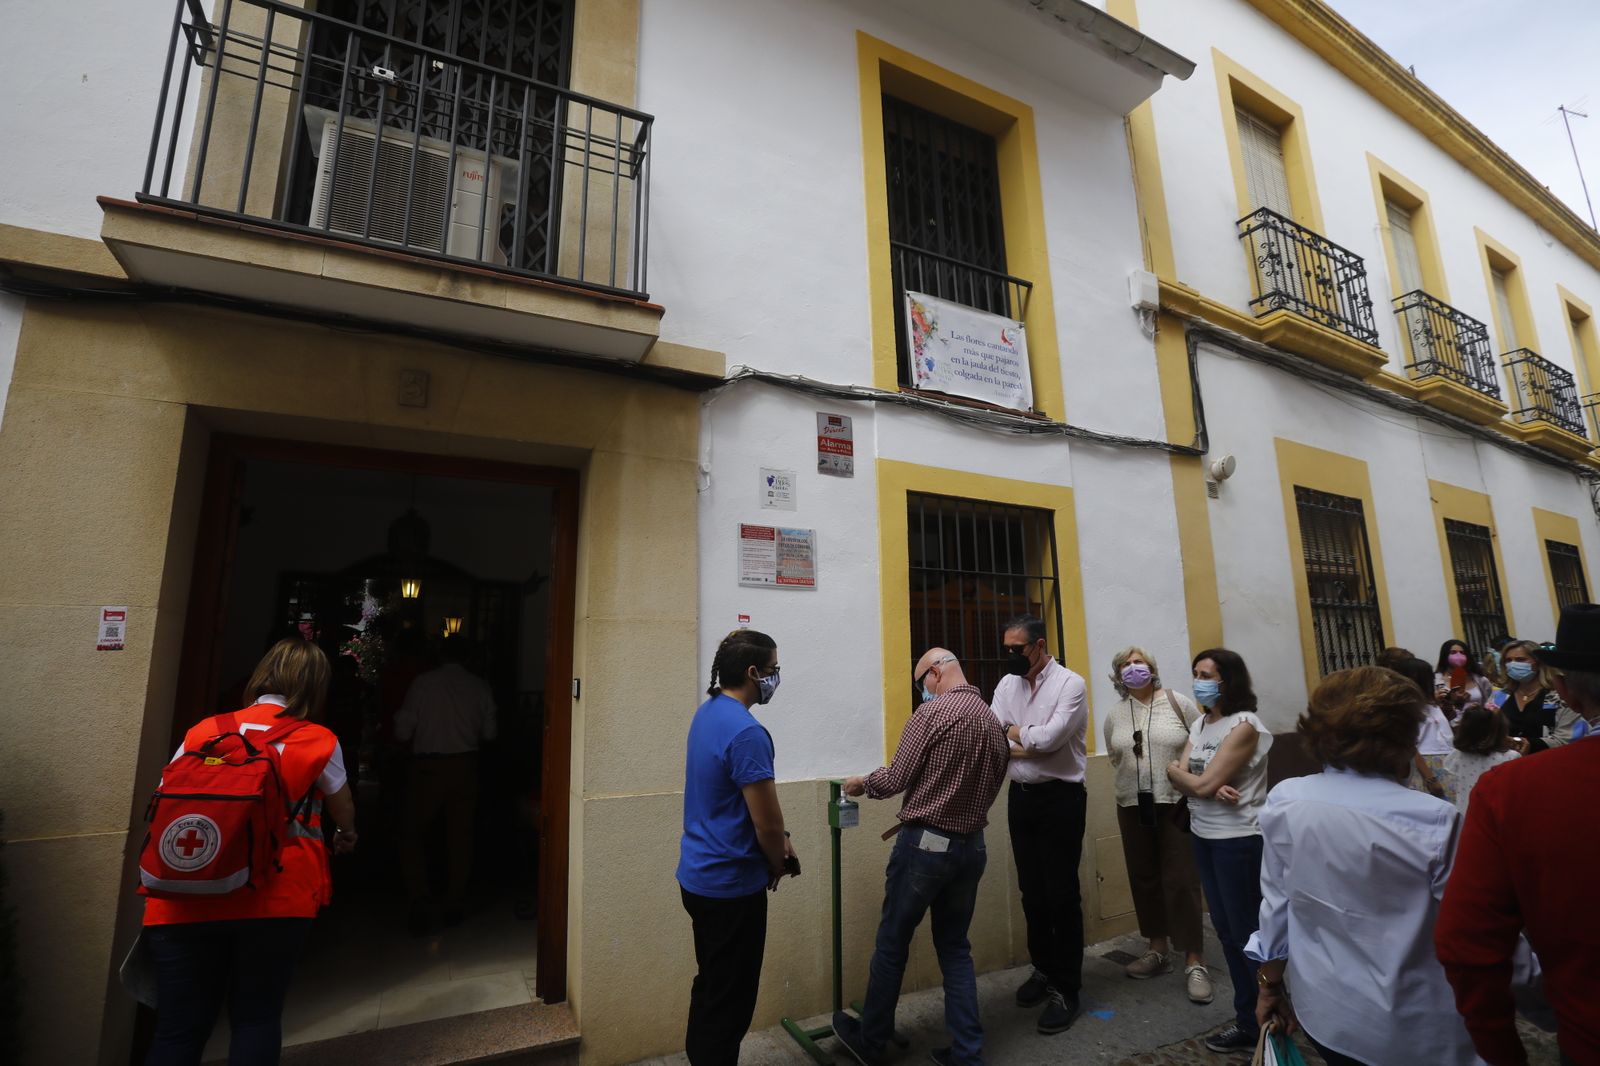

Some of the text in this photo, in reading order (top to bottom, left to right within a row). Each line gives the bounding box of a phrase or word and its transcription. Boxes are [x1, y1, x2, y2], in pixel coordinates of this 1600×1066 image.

[951, 330, 964, 341] Las
[966, 335, 986, 347] flores
[980, 352, 994, 362] que
[950, 356, 960, 364] en
[962, 358, 969, 366] la
[970, 360, 988, 370] jaula
[988, 364, 1000, 374] del
[954, 369, 982, 382] colgada
[994, 377, 1000, 385] la
[820, 438, 851, 450] Alarma
[178, 820, 209, 830] Cruz Roja
